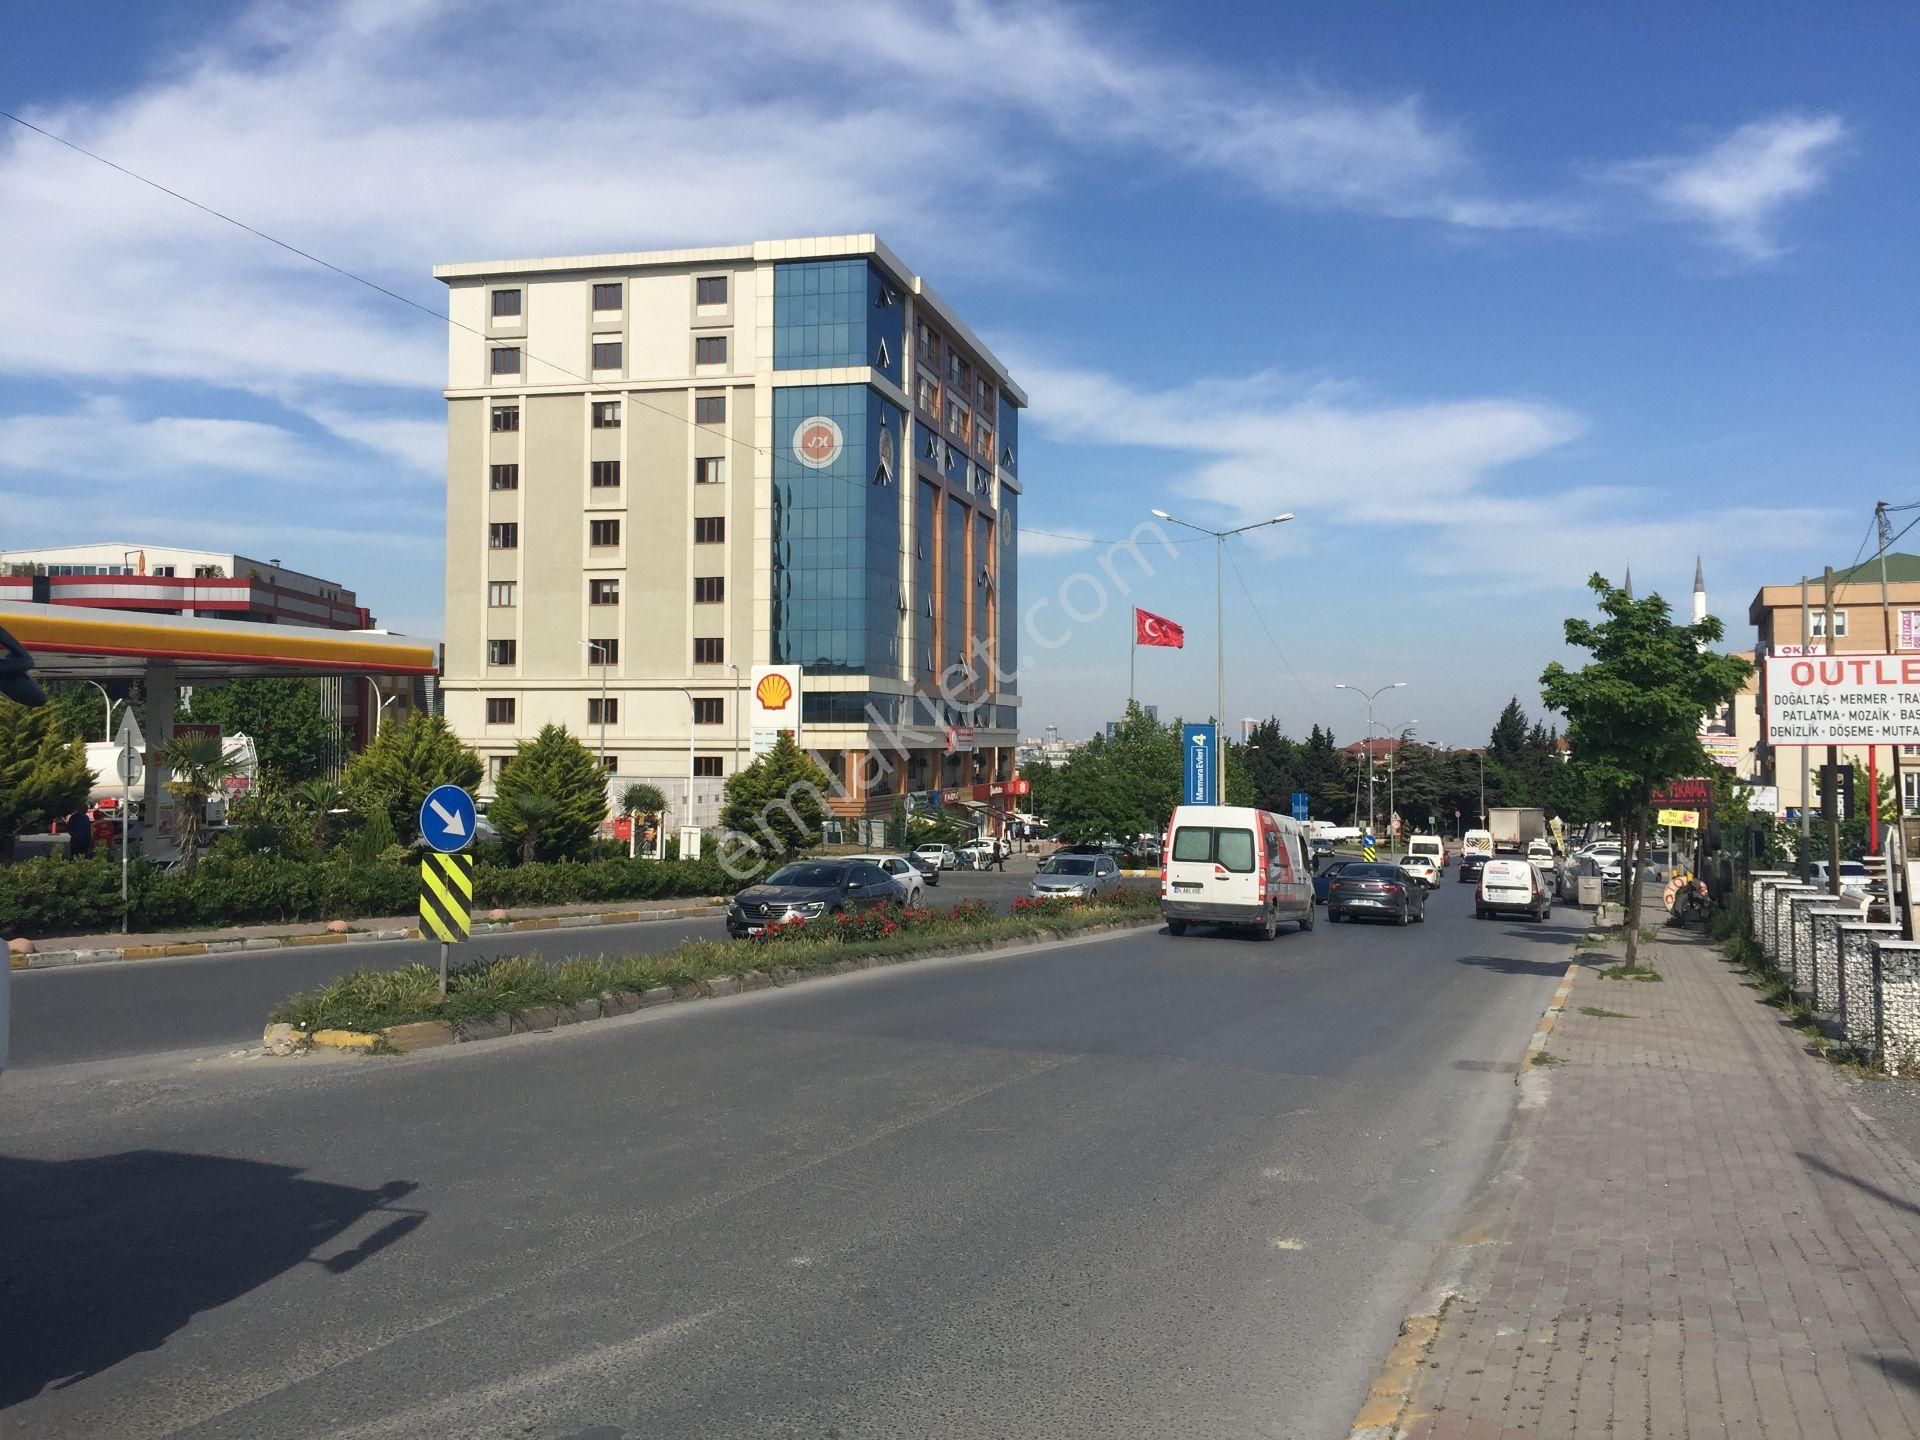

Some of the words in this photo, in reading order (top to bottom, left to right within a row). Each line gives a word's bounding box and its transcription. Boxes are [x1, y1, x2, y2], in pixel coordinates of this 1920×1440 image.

[1791, 658, 1920, 686] OUTLE
[1774, 692, 1830, 706] DOĞALTAŞ
[1840, 693, 1888, 705] MERMER
[1898, 693, 1920, 704] TRA
[1783, 710, 1840, 721] PATLATMA
[1848, 708, 1890, 721] MOZAİK
[1770, 724, 1819, 737] DENİZLİK
[1829, 723, 1874, 738] DÖŞEME
[1192, 733, 1207, 746] 4
